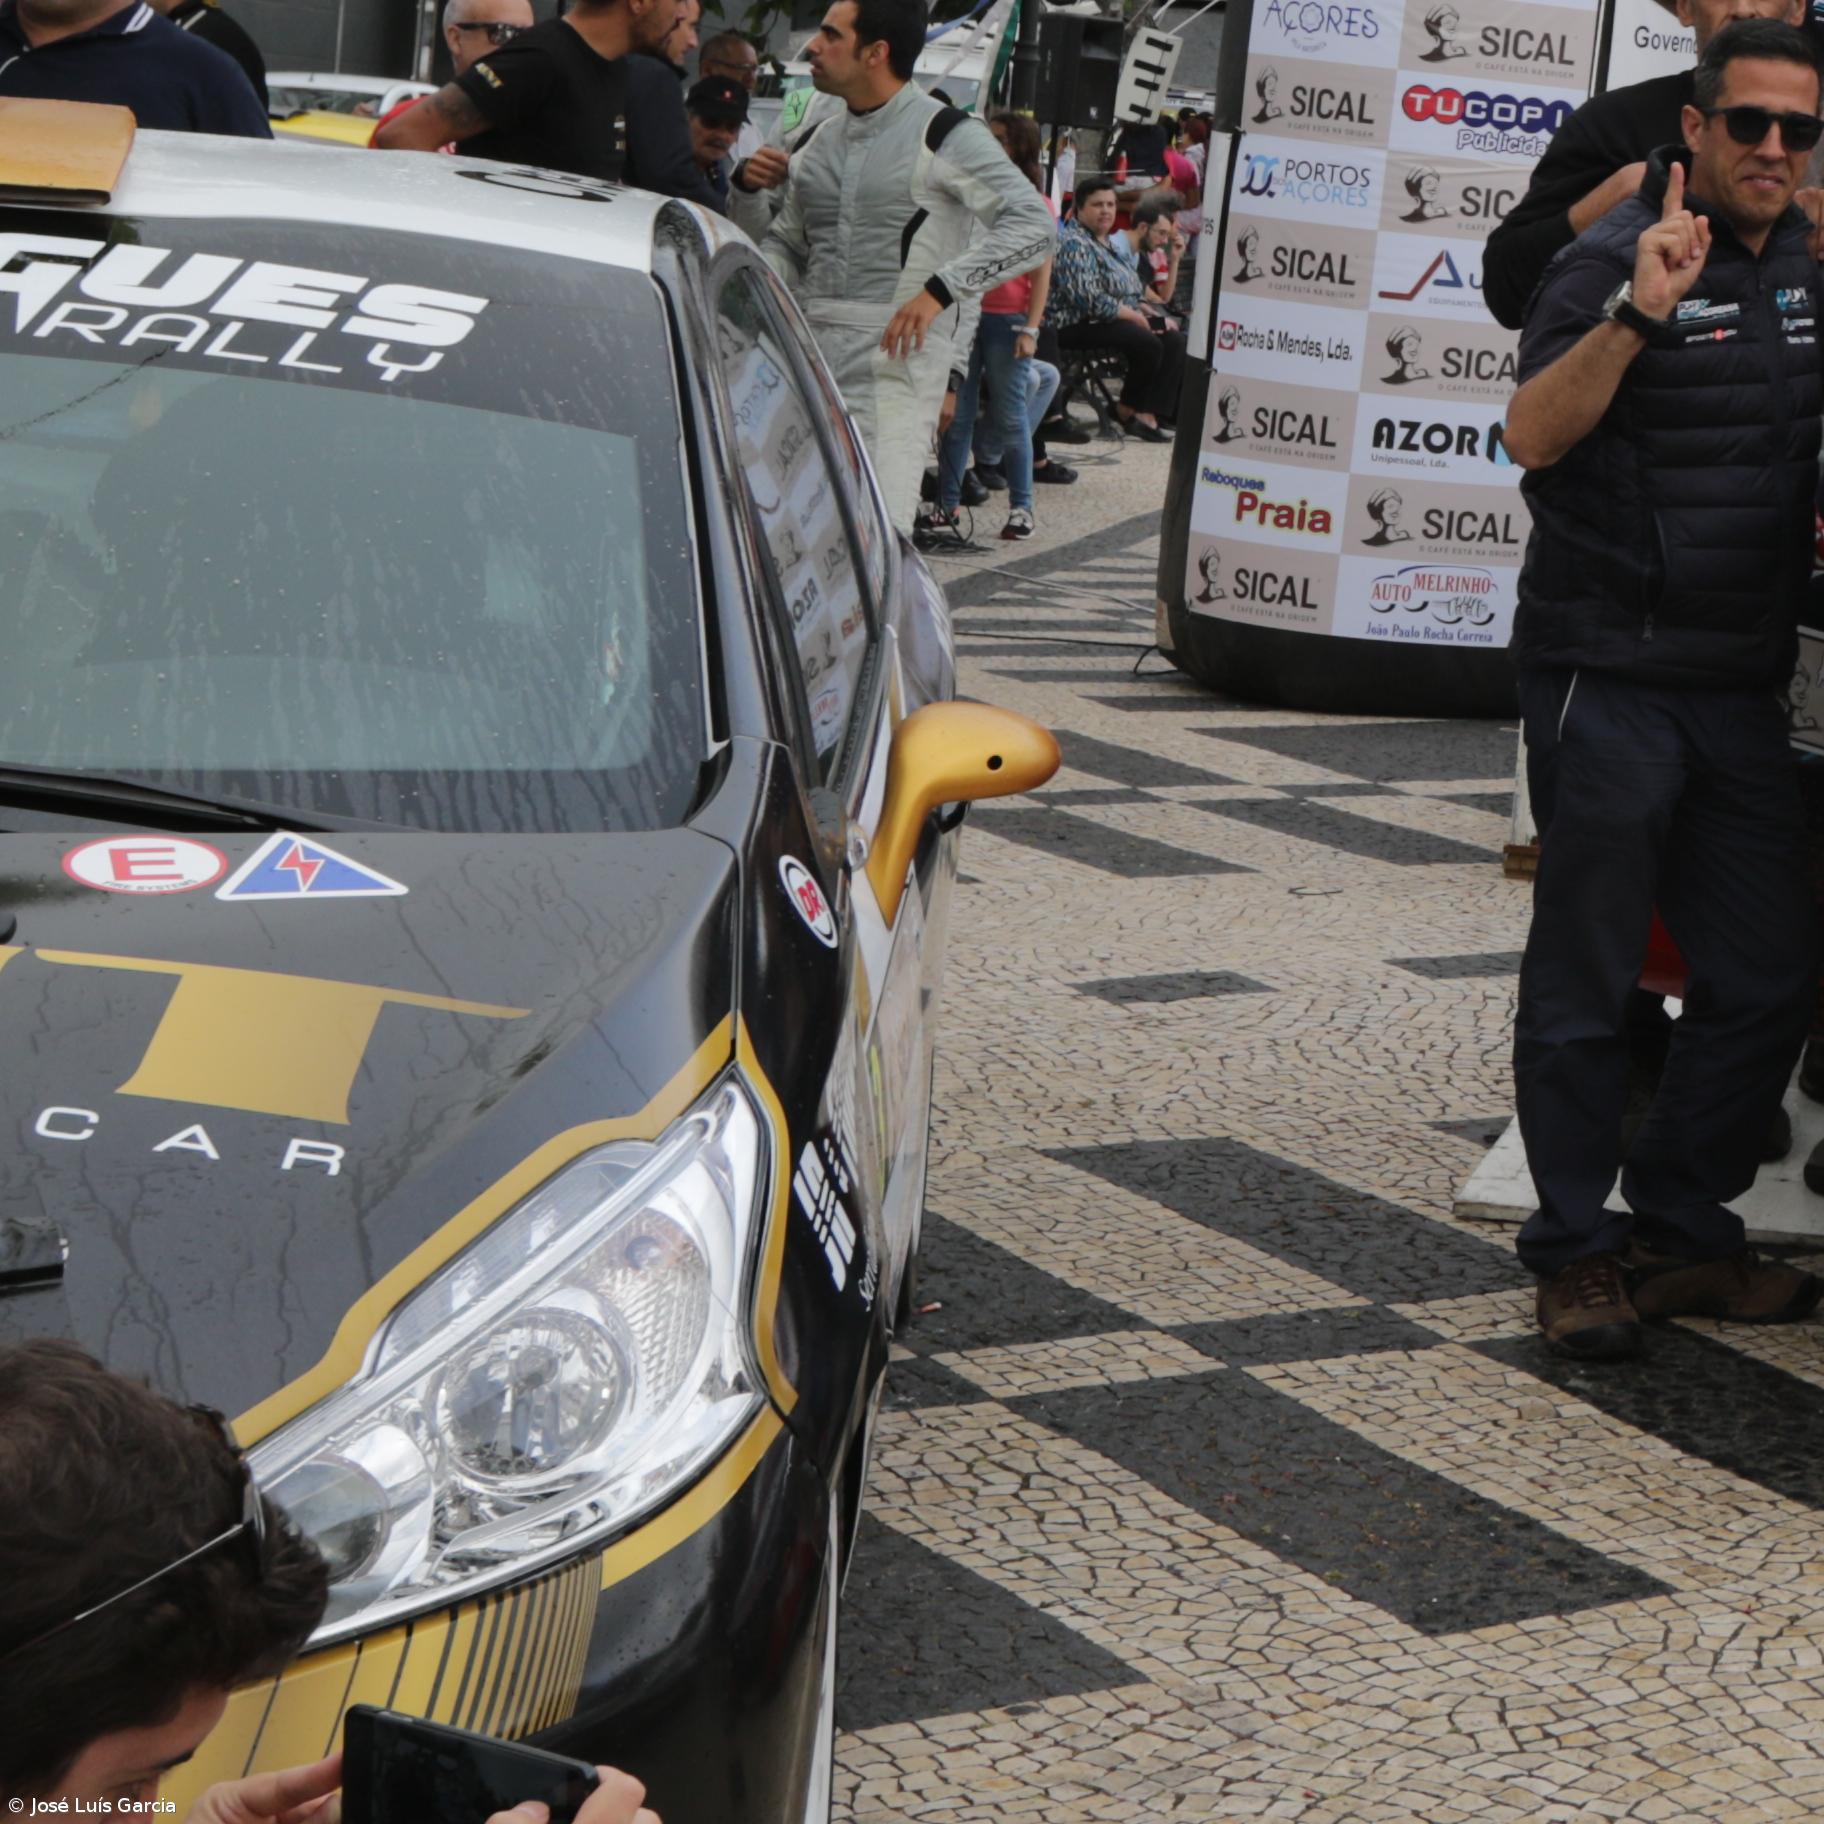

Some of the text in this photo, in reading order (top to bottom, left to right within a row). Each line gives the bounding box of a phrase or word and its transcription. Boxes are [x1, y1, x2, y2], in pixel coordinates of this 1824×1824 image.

[1478, 25, 1576, 66] SICAL
[1289, 85, 1375, 125] SICAL
[1406, 91, 1565, 128] TUCOPI
[1457, 129, 1548, 157] Publicida
[1284, 159, 1372, 188] PORTOS
[1282, 182, 1369, 208] AÇORES
[1459, 185, 1516, 219] SIC
[1270, 245, 1356, 287] SICAL
[34, 301, 445, 382] RALLY
[1236, 324, 1265, 351] Rocha
[1266, 332, 1275, 351] &
[1276, 331, 1325, 364] Mendes,
[1327, 339, 1353, 362] Lda.
[1440, 346, 1518, 383] SICA
[1251, 406, 1337, 448] SICAL
[1234, 490, 1332, 535] Praia
[1421, 508, 1519, 545] SICAL
[1232, 567, 1318, 610] SICAL
[1371, 572, 1491, 603] AUTO MELRINHO
[1365, 621, 1389, 636] João
[1391, 624, 1420, 639] Paulo
[1423, 625, 1454, 641] Rocha
[136, 879, 199, 892] SYSTEMS
